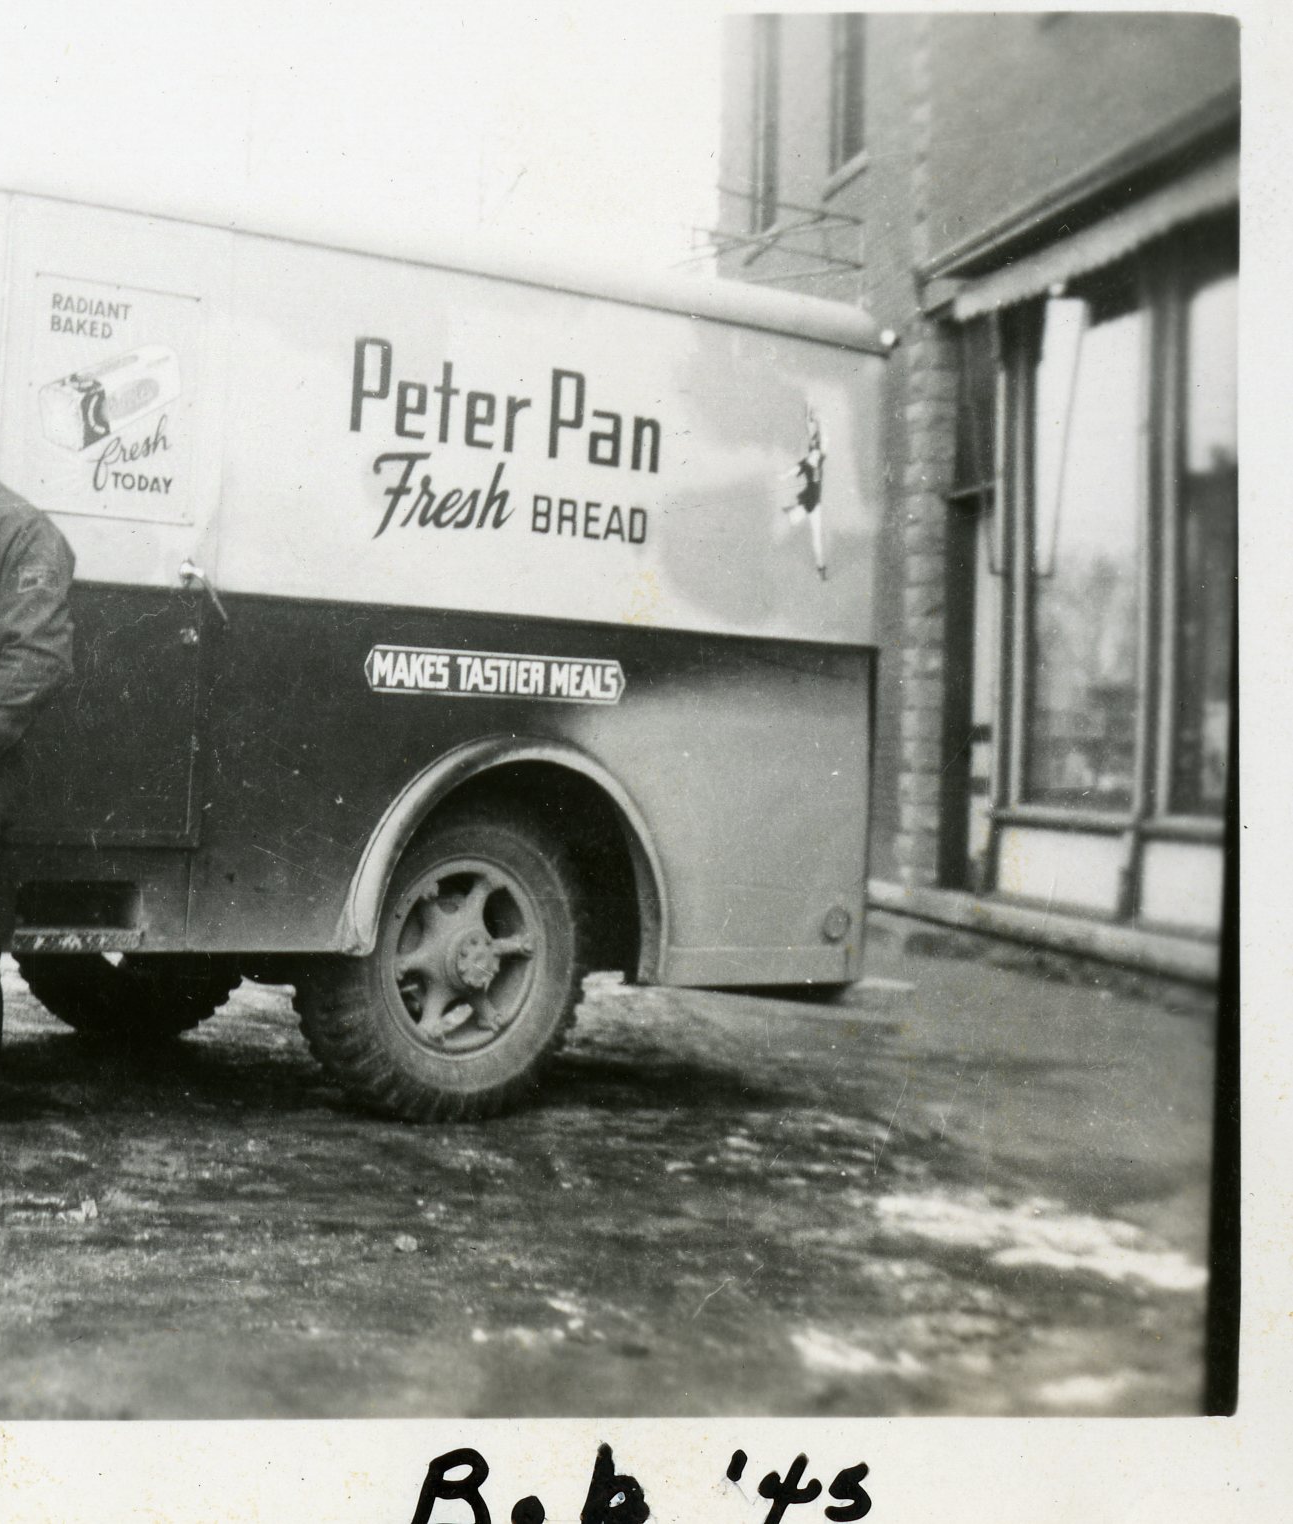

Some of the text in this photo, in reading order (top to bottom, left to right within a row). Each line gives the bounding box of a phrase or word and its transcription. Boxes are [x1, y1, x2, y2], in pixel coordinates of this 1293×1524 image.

[51, 315, 113, 339] BAKED
[52, 293, 132, 320] RADIANT
[349, 336, 661, 474] Peter Pan
[92, 413, 172, 491] fresh
[112, 471, 172, 494] TODAY
[373, 452, 648, 545] Fresh BREAD
[372, 651, 618, 699] MAKES TASTIER MEALS
